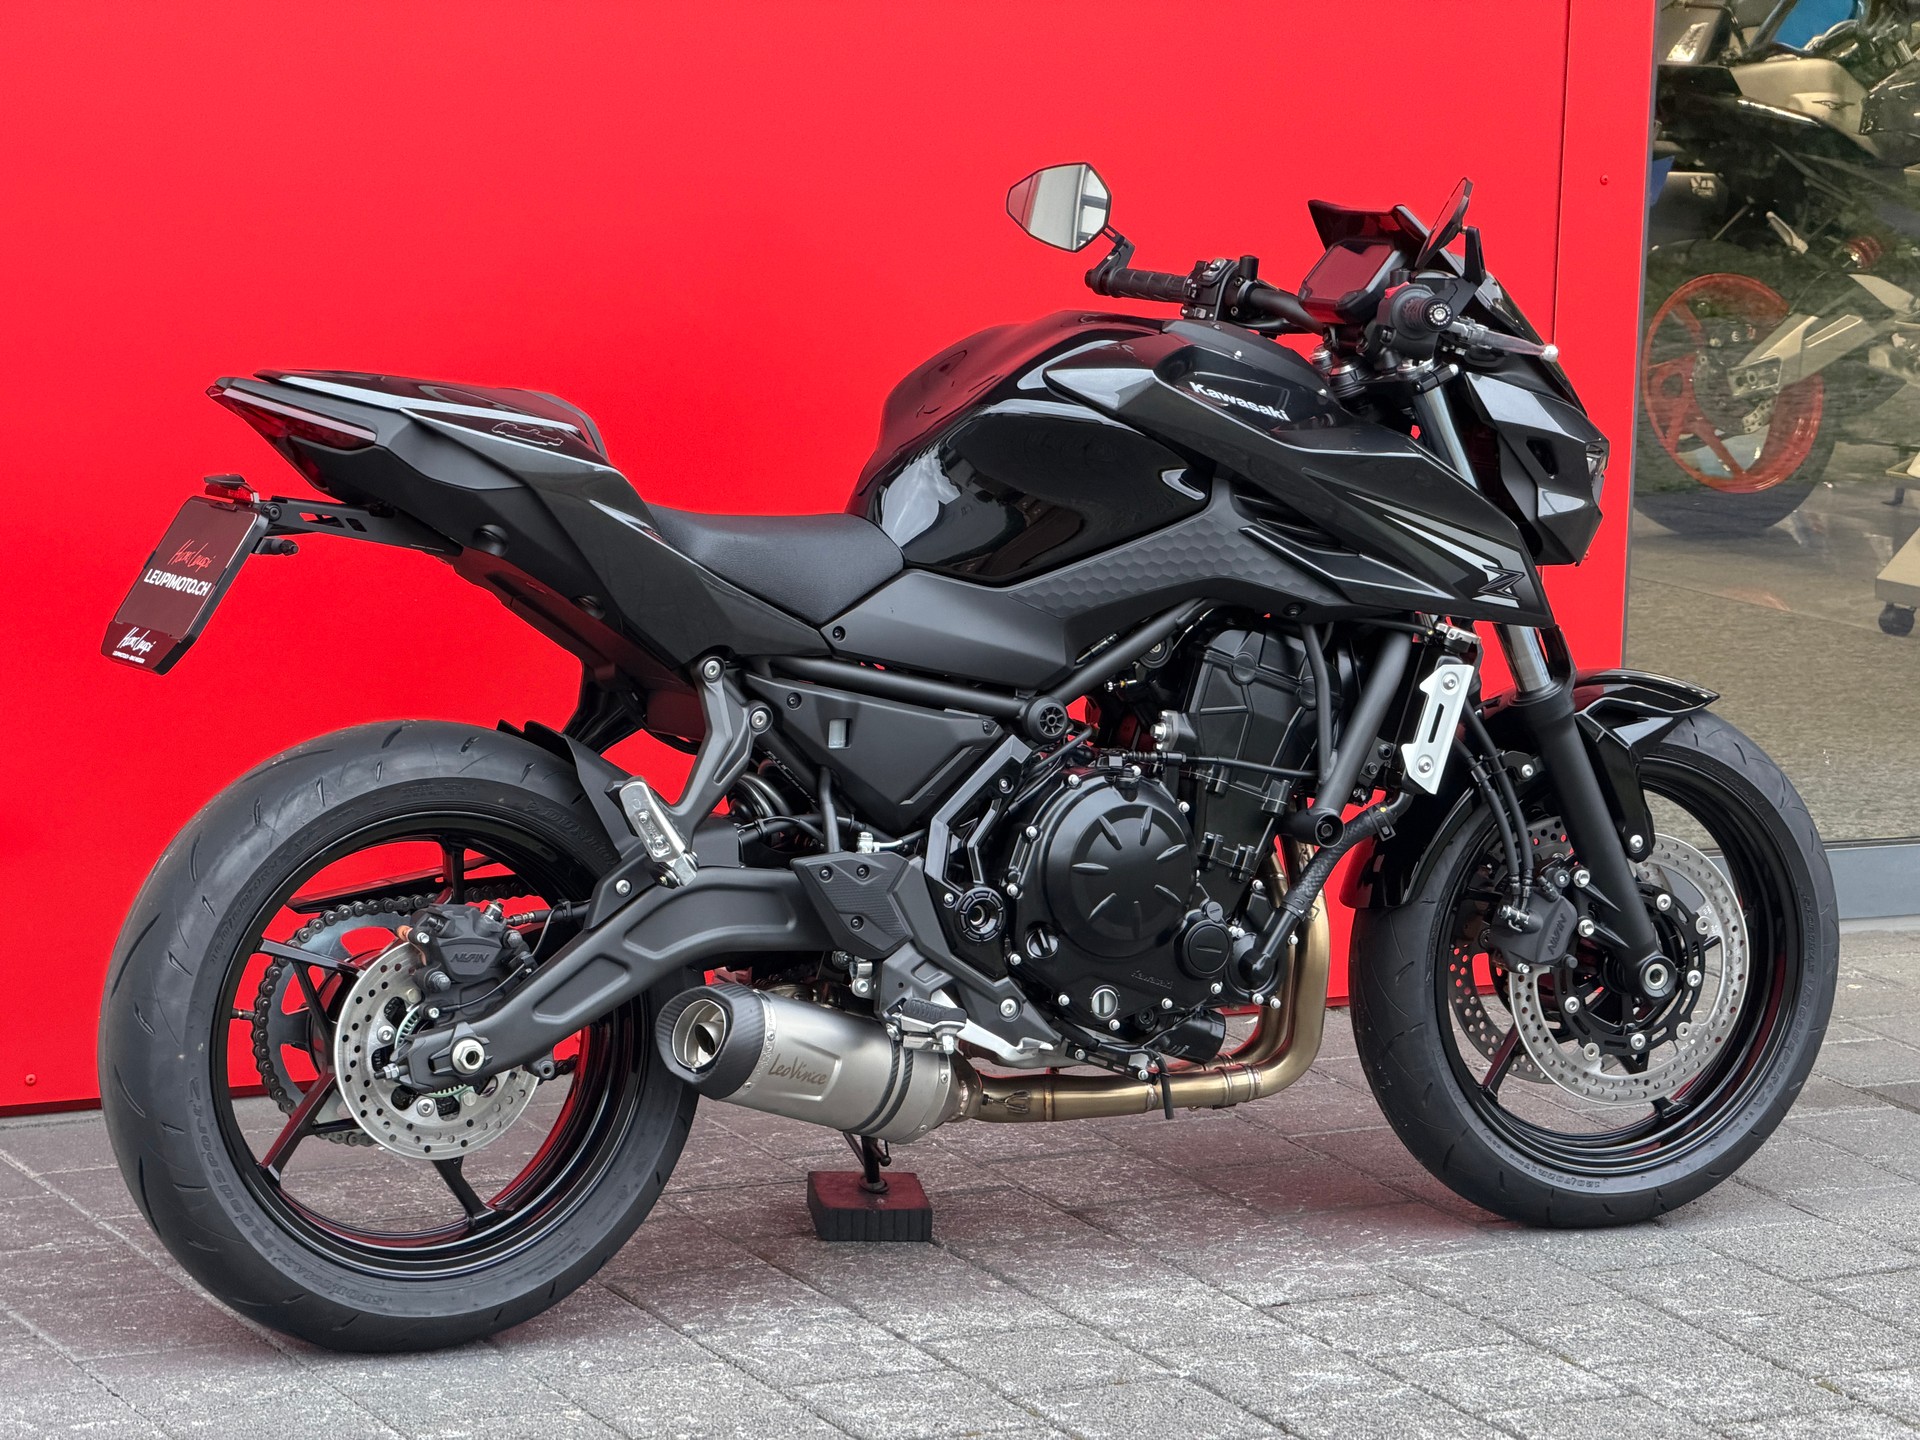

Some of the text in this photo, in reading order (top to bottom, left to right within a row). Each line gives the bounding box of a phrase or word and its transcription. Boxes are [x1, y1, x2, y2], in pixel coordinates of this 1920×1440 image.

[1189, 381, 1291, 422] Kawasaki
[144, 569, 212, 597] LEUPIMOTO.CH
[768, 1053, 827, 1085] LeoVince
